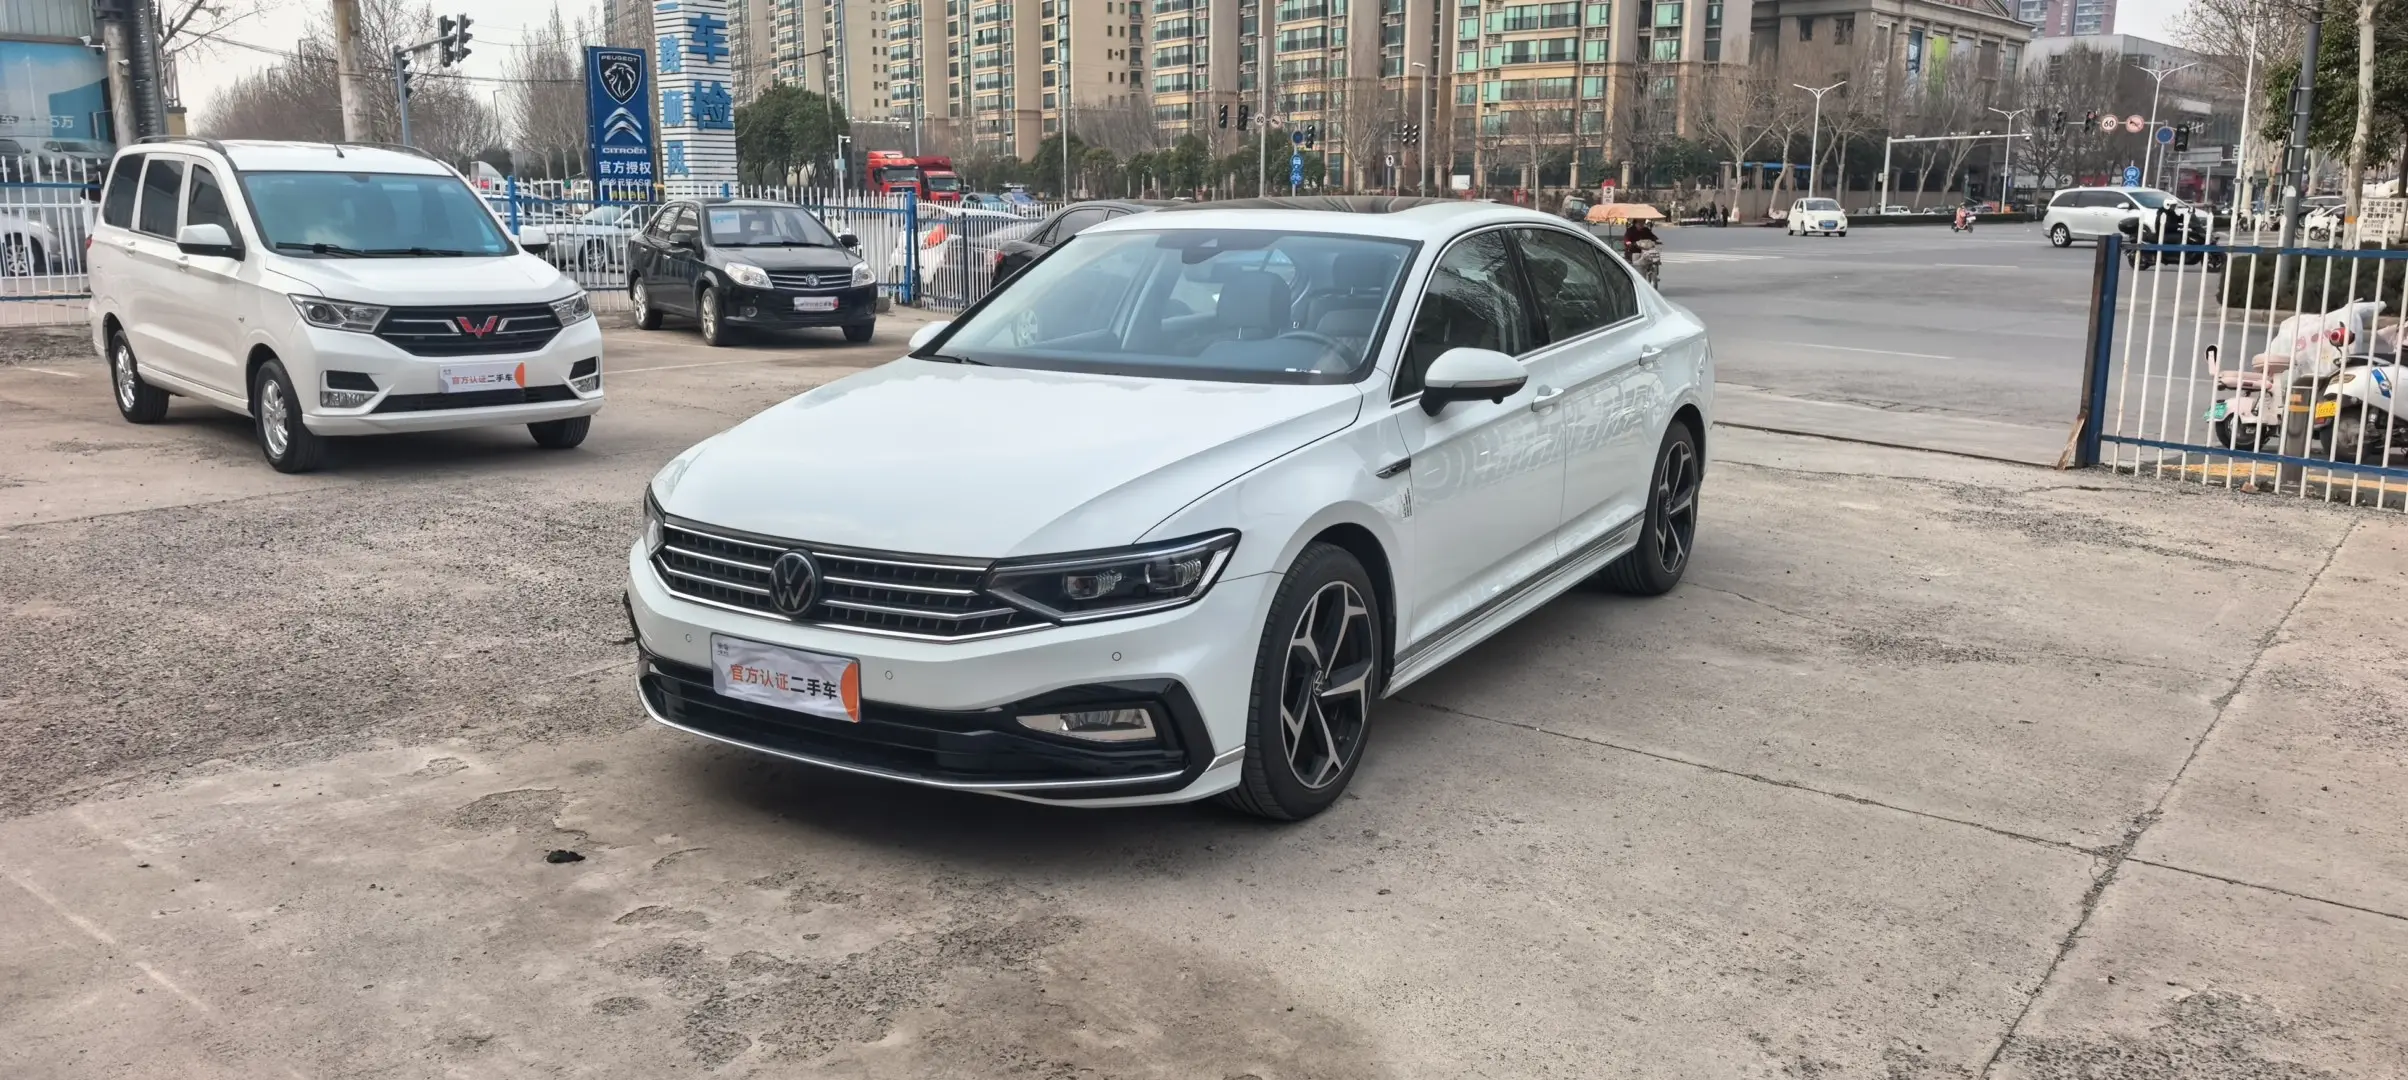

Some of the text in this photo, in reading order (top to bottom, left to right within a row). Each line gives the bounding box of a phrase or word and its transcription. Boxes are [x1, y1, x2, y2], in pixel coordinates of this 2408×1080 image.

[601, 54, 638, 62] PEUGEOT
[687, 13, 734, 132] 车检
[2103, 120, 2114, 128] 60
[599, 160, 652, 174] 官方授权
[452, 373, 513, 385] 官方认证二手车
[730, 664, 838, 700] 官方认证二手车
